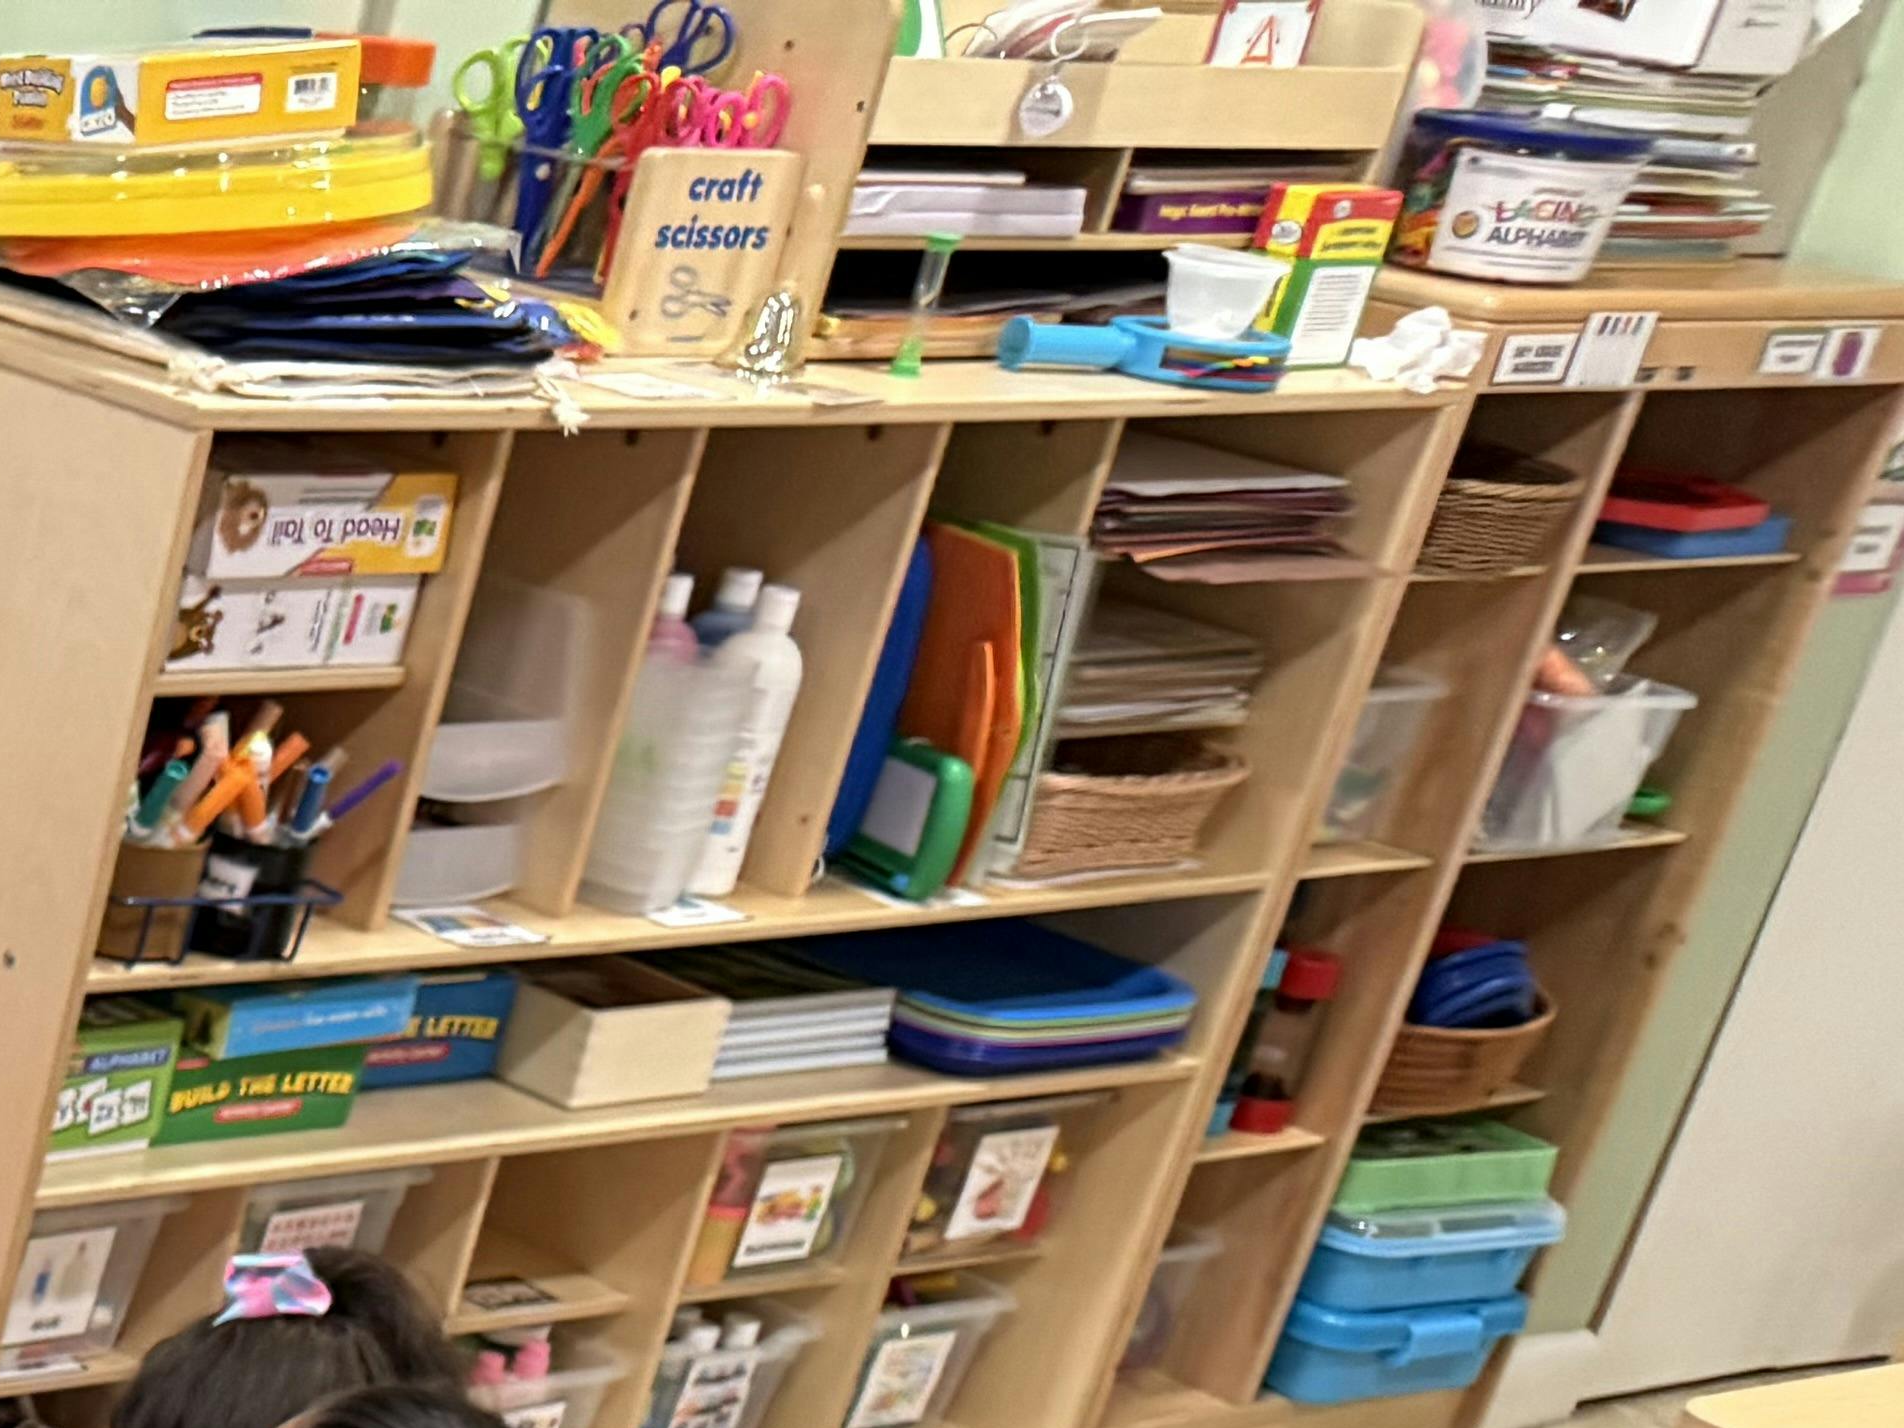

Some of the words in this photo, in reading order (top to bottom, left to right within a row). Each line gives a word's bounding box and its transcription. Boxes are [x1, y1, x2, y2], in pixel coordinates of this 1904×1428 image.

[688, 168, 764, 203] craft
[654, 214, 769, 250] scissors
[271, 517, 305, 546] Tail
[313, 518, 334, 544] To
[341, 516, 401, 548] Head
[429, 1015, 500, 1039] LETTER
[280, 1070, 355, 1095] LETTER
